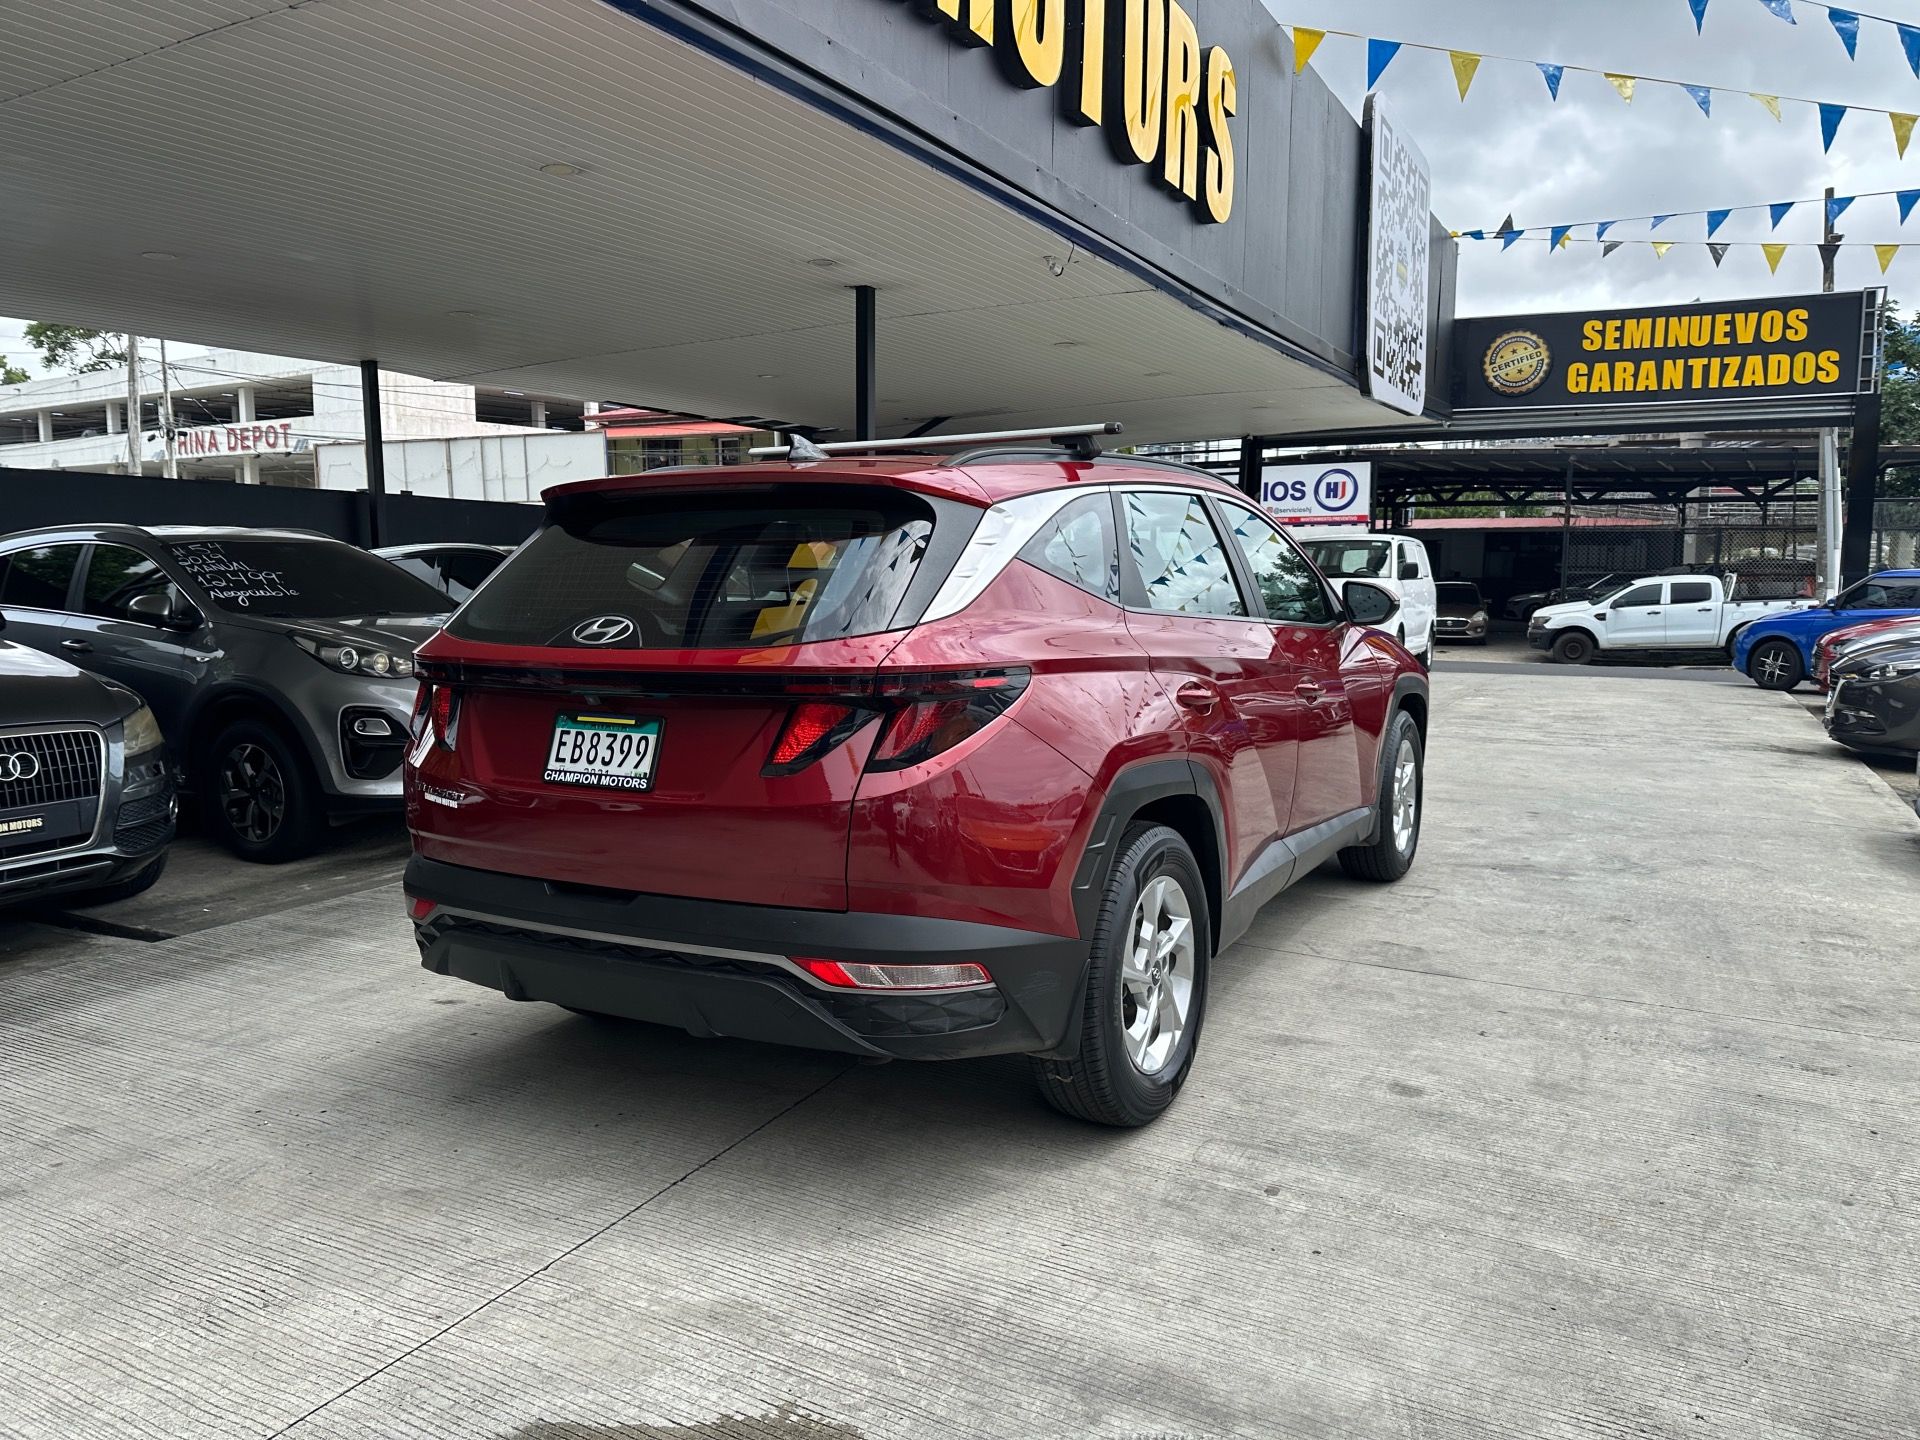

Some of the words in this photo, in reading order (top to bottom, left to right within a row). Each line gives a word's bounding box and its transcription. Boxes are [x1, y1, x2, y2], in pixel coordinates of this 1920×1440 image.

[936, 0, 1237, 224] ORS
[1581, 308, 1809, 351] SEMINUEVOS
[1491, 350, 1542, 374] CERTIFIED
[1566, 350, 1840, 394] GARANTIZADOS
[226, 423, 291, 452] DEPOT
[1325, 480, 1347, 500] HJ
[178, 553, 228, 566] 2019
[185, 561, 257, 574] MANUAL
[209, 585, 300, 606] Negociable
[554, 729, 650, 770] EB8399
[544, 770, 598, 785] CHAMPION
[600, 775, 648, 789] MOTORS
[9, 818, 43, 831] MOTORS
